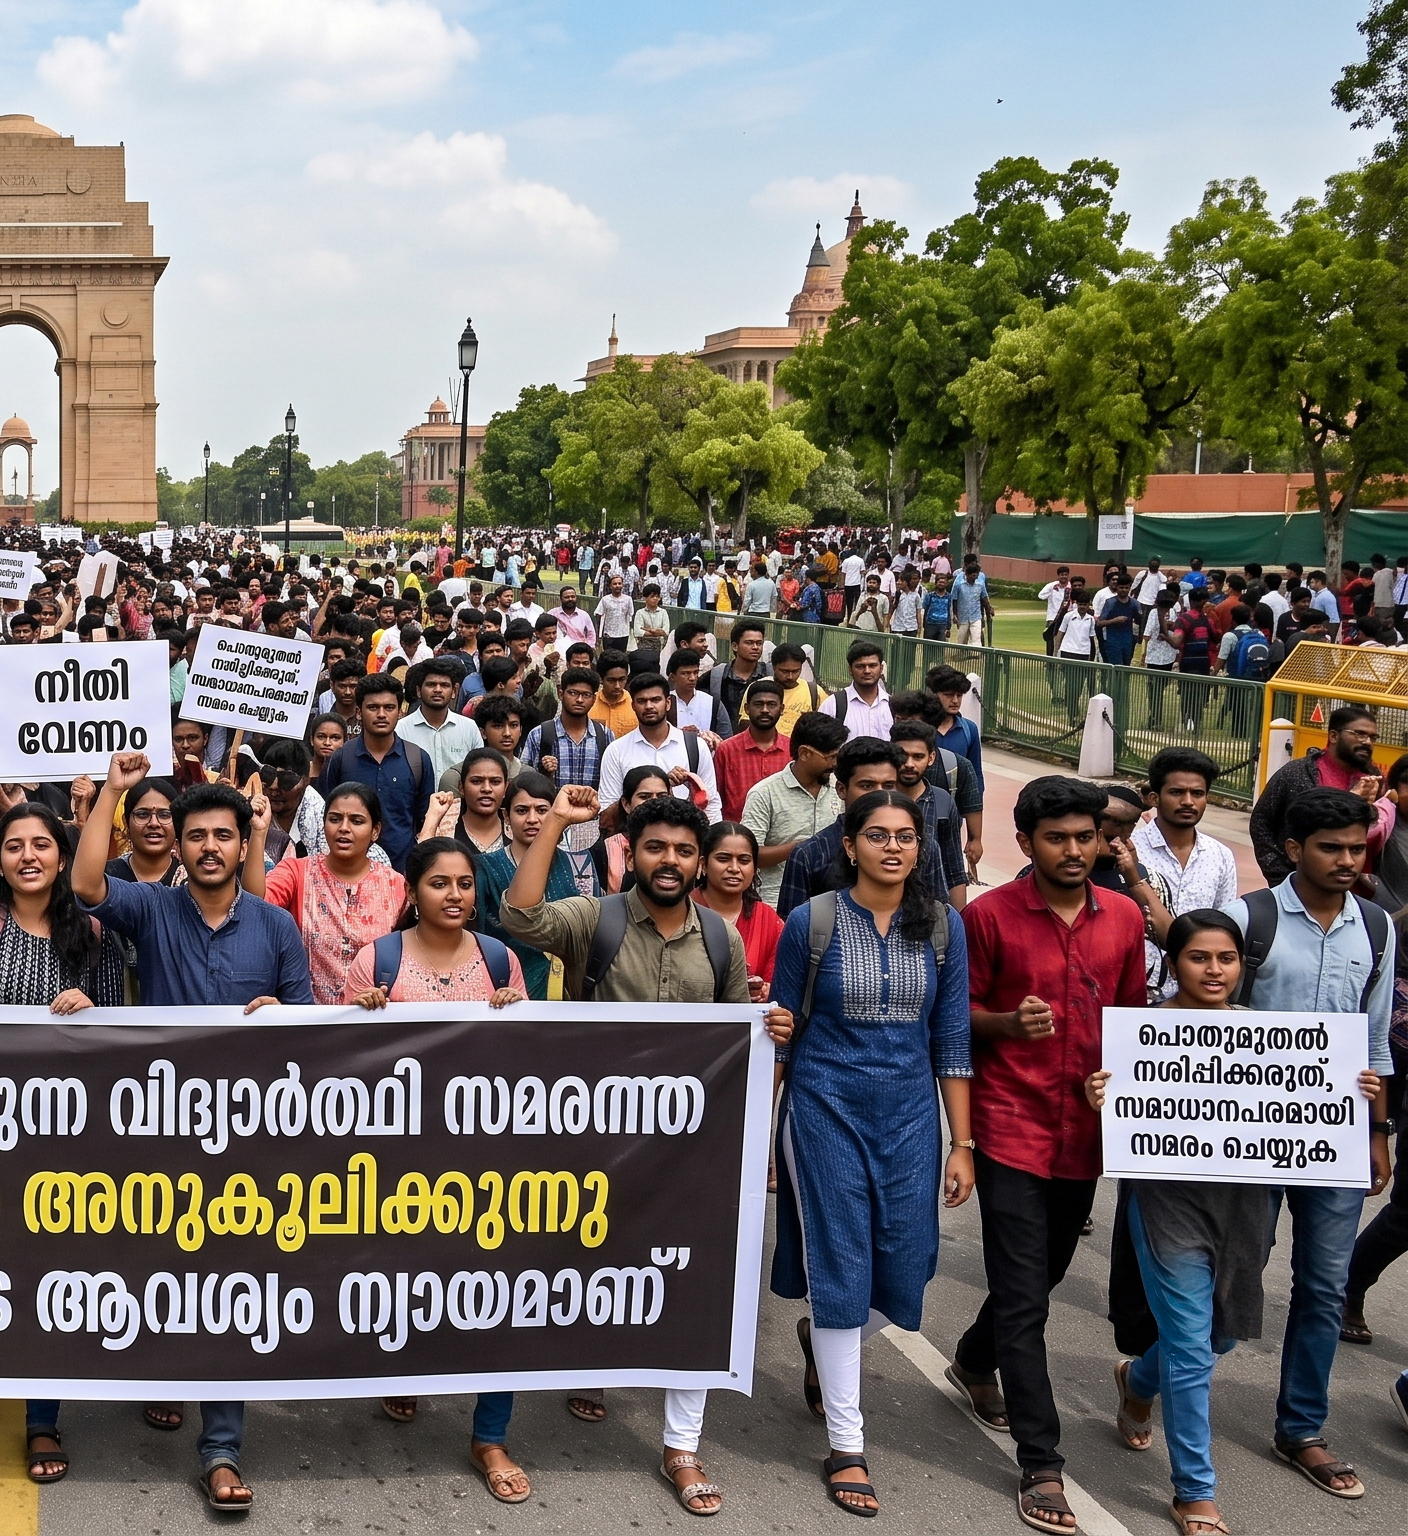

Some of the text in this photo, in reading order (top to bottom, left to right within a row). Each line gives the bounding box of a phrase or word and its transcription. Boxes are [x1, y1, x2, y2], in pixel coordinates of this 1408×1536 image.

[34, 657, 129, 703] നീതി
[18, 719, 148, 755] വേണം
[1138, 1022, 1329, 1055] പൊതുമുതൽ
[109, 1057, 423, 1155] വിദ്യാർത്ഥി
[1114, 1096, 1355, 1126] സമാധാനപരമായി
[1130, 1132, 1337, 1169] സമരം ചെയ്യുക
[23, 1152, 610, 1253] അനുകൂലിക്കുന്നു
[36, 1270, 314, 1355] ആവശ്യം
